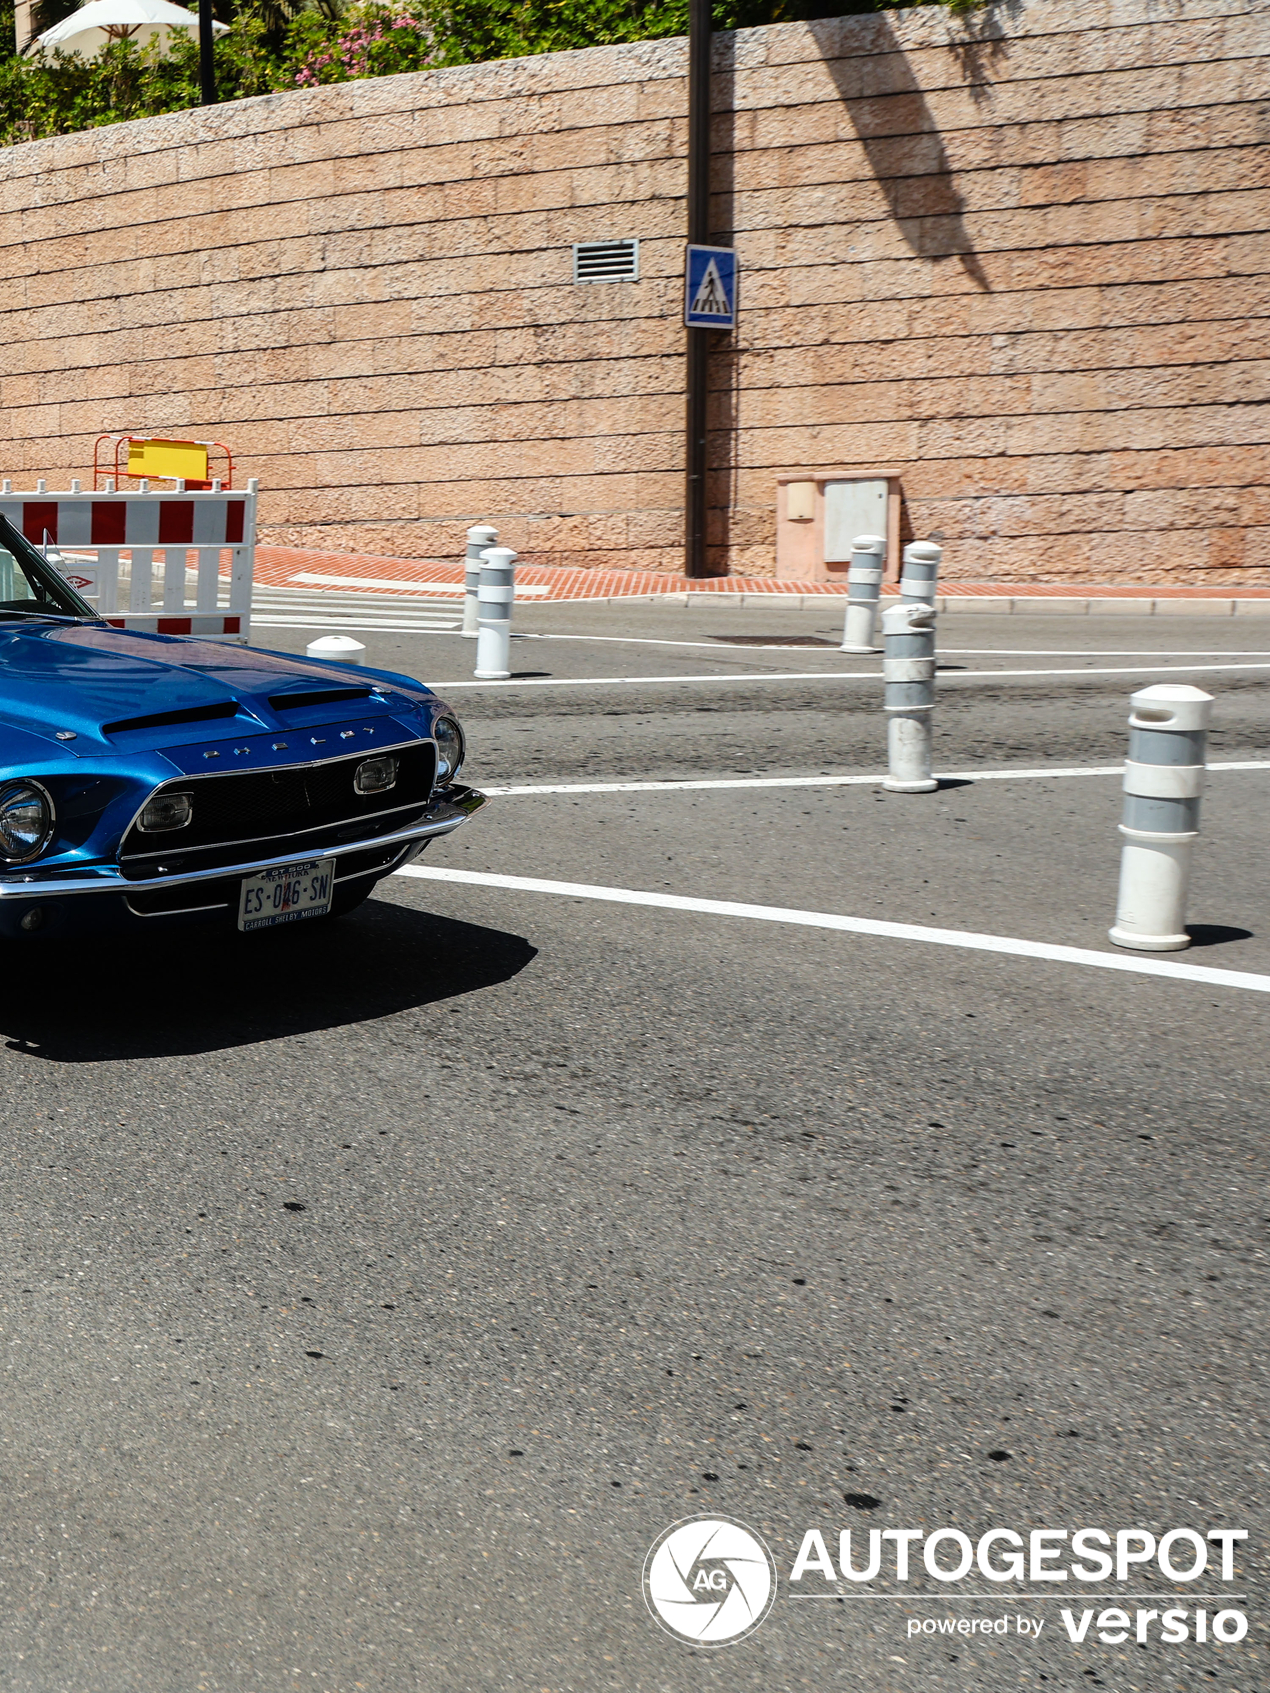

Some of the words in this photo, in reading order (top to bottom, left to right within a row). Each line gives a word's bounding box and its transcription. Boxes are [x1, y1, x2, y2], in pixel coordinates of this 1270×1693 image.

[288, 863, 311, 872] 500
[245, 919, 272, 930] CARROLL
[275, 912, 298, 924] SHELBY
